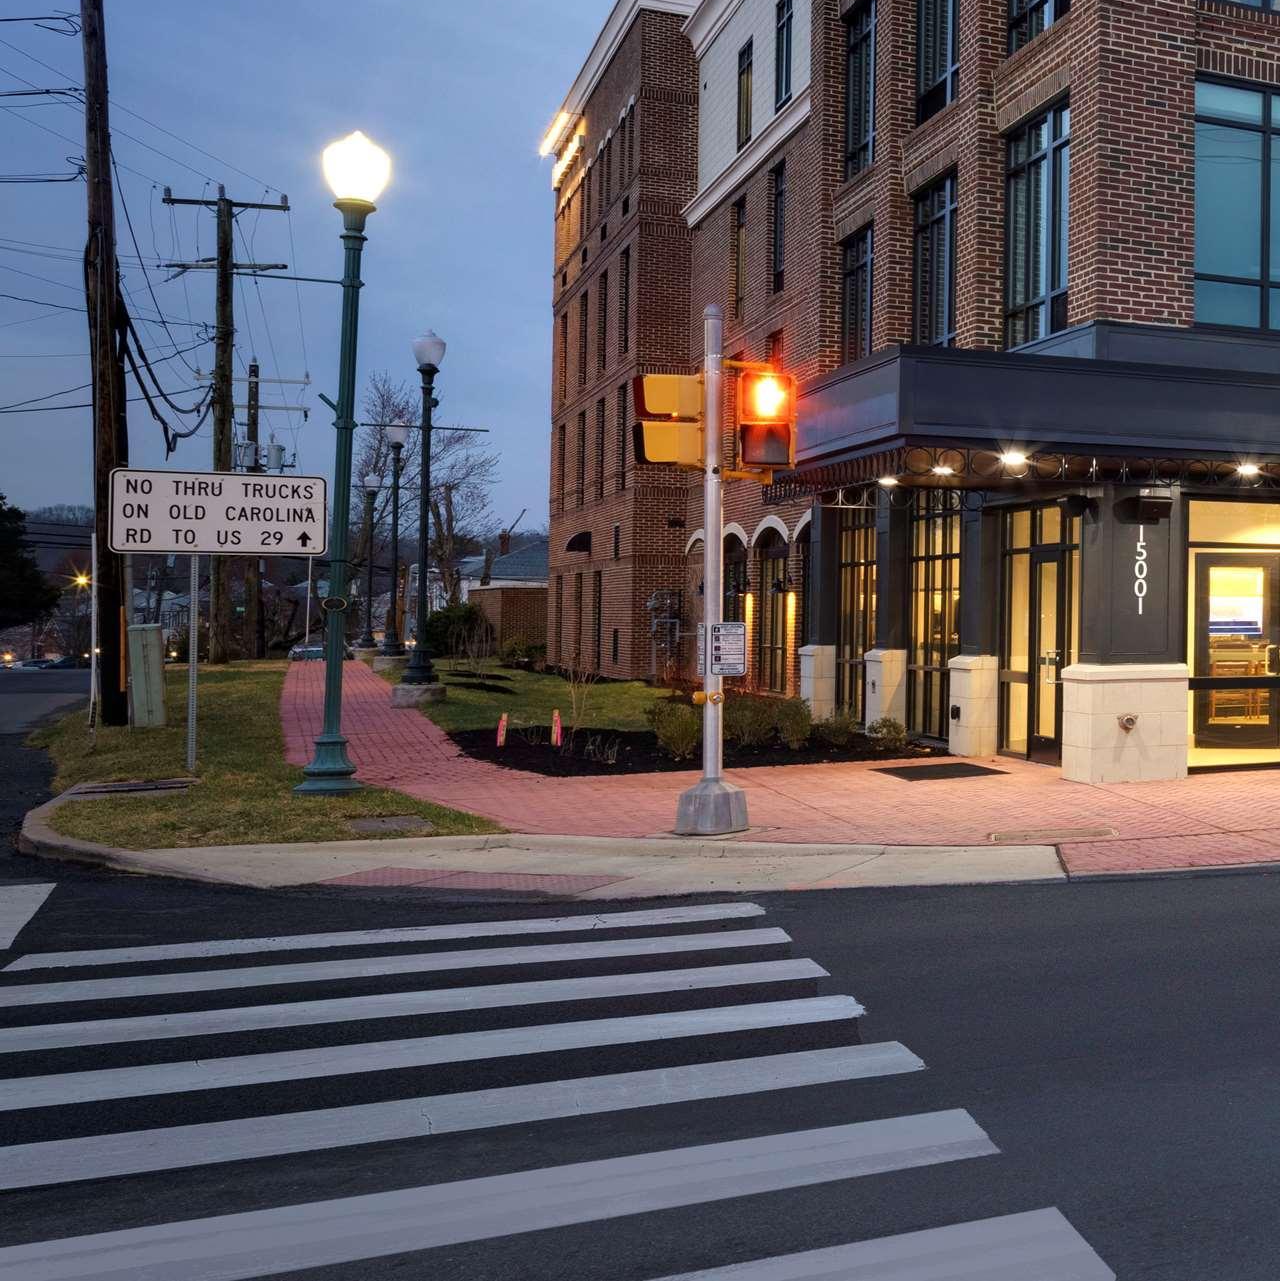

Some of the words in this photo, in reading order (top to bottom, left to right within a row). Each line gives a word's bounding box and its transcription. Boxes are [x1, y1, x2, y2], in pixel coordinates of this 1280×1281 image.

[125, 478, 153, 495] NO
[173, 480, 223, 497] THRU
[242, 483, 314, 500] TRUCKS
[122, 503, 149, 519] ON
[169, 504, 206, 521] OLD
[225, 506, 316, 523] CAROLINA
[125, 528, 151, 544] RD
[172, 529, 196, 545] TO
[216, 530, 242, 546] US
[260, 531, 284, 546] 29
[1134, 524, 1147, 615] 15001
